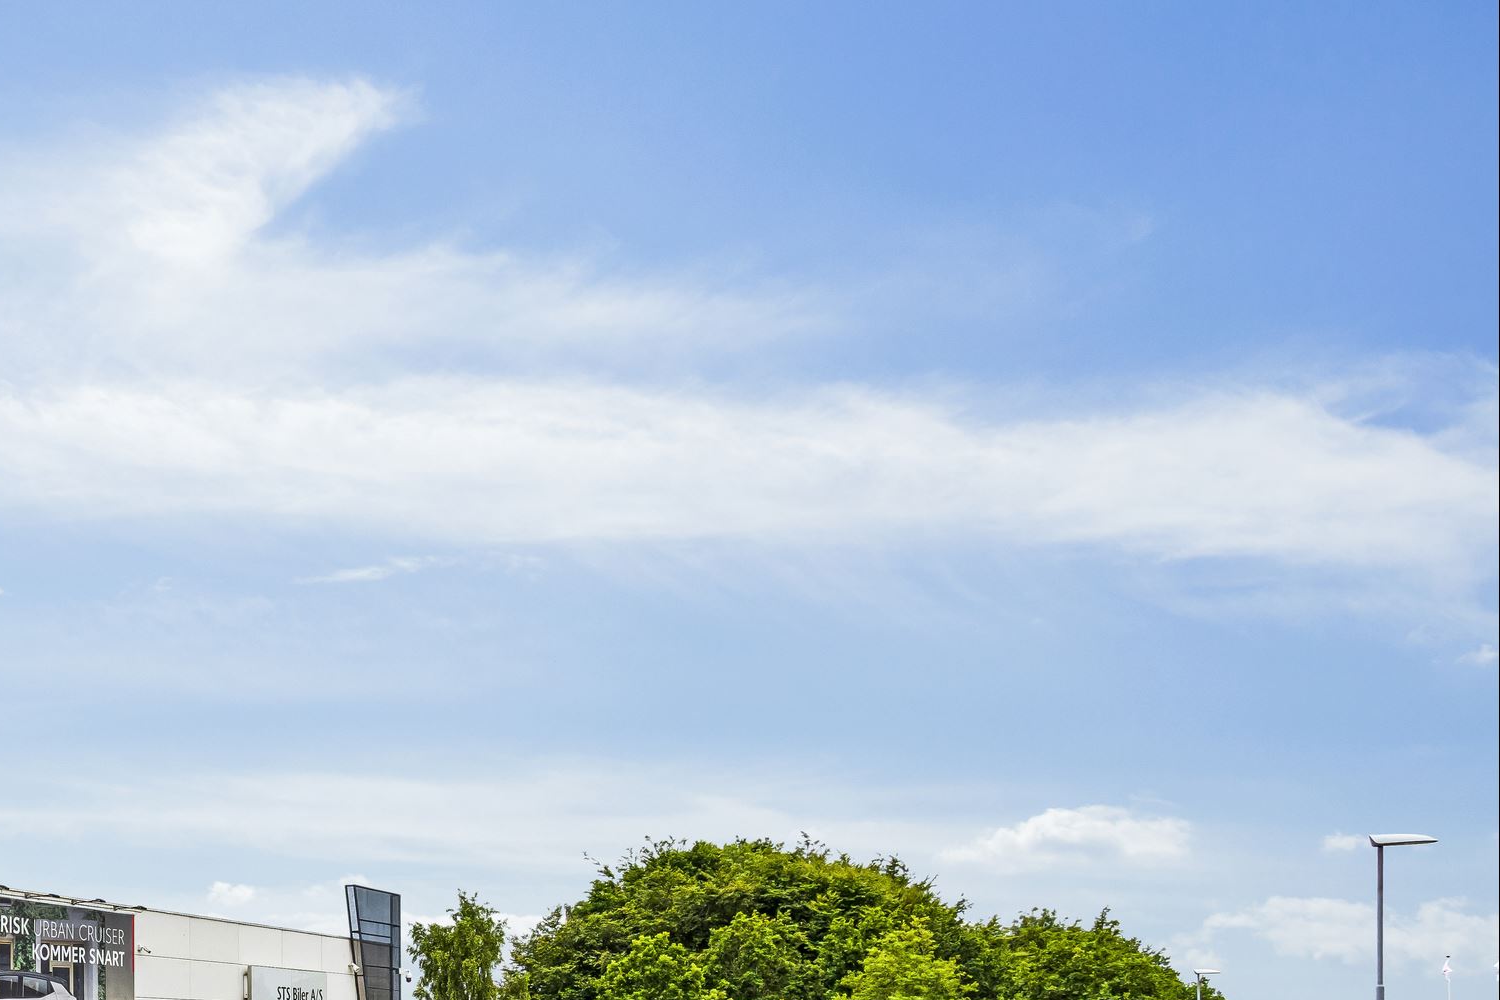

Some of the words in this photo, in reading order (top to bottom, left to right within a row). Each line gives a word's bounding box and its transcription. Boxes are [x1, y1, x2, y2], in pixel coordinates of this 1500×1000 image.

[33, 919, 75, 940] URBAN
[78, 924, 125, 945] CRUISER
[32, 942, 86, 964] KOMMER
[89, 947, 125, 967] SNART
[277, 986, 290, 1000] STS
